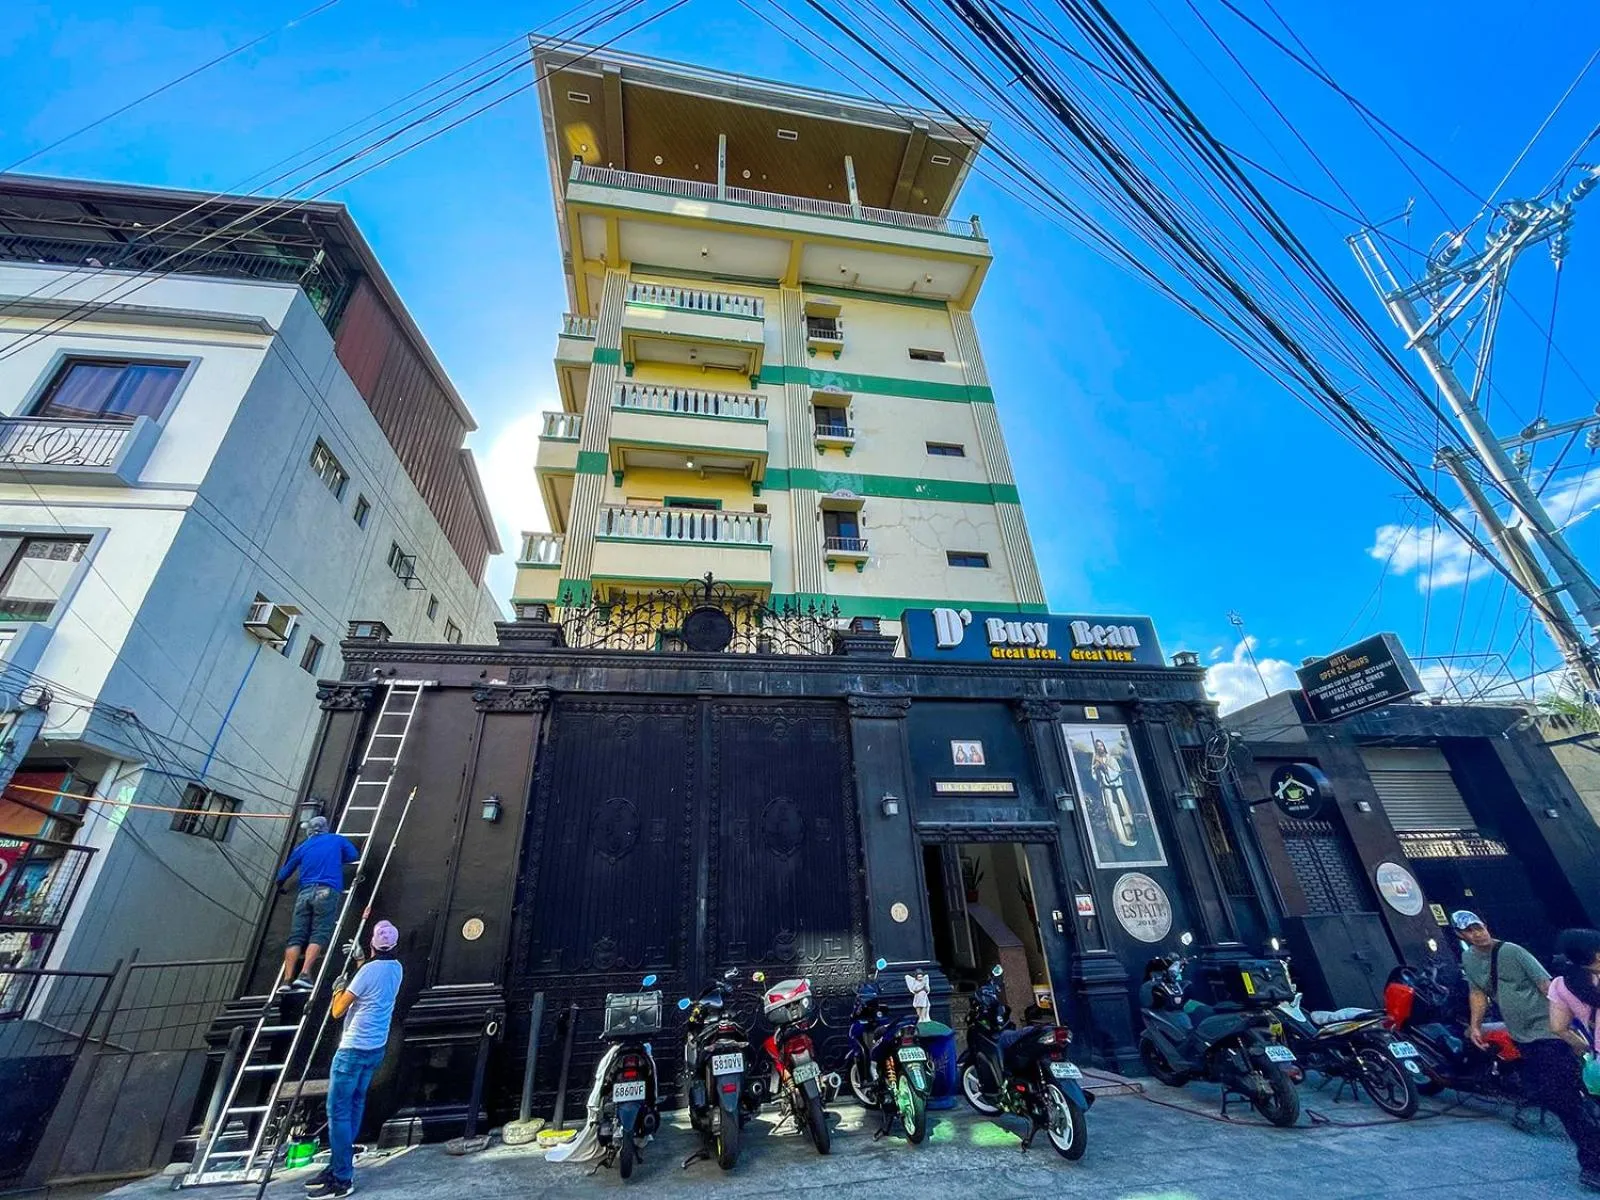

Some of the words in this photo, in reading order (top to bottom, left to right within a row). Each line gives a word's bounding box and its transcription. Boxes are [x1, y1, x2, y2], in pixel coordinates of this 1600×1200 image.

[985, 618, 1048, 648] Busy
[1069, 620, 1140, 648] Bean
[991, 647, 1025, 659] Great
[1027, 648, 1061, 660] Brew.
[1071, 648, 1103, 661] Great
[1104, 649, 1137, 661] View.
[1329, 654, 1350, 667] HOTEL
[1319, 668, 1337, 681] OPEN
[1337, 665, 1347, 673] 24
[1346, 655, 1369, 669] HOURS
[1121, 888, 1157, 902] CPG
